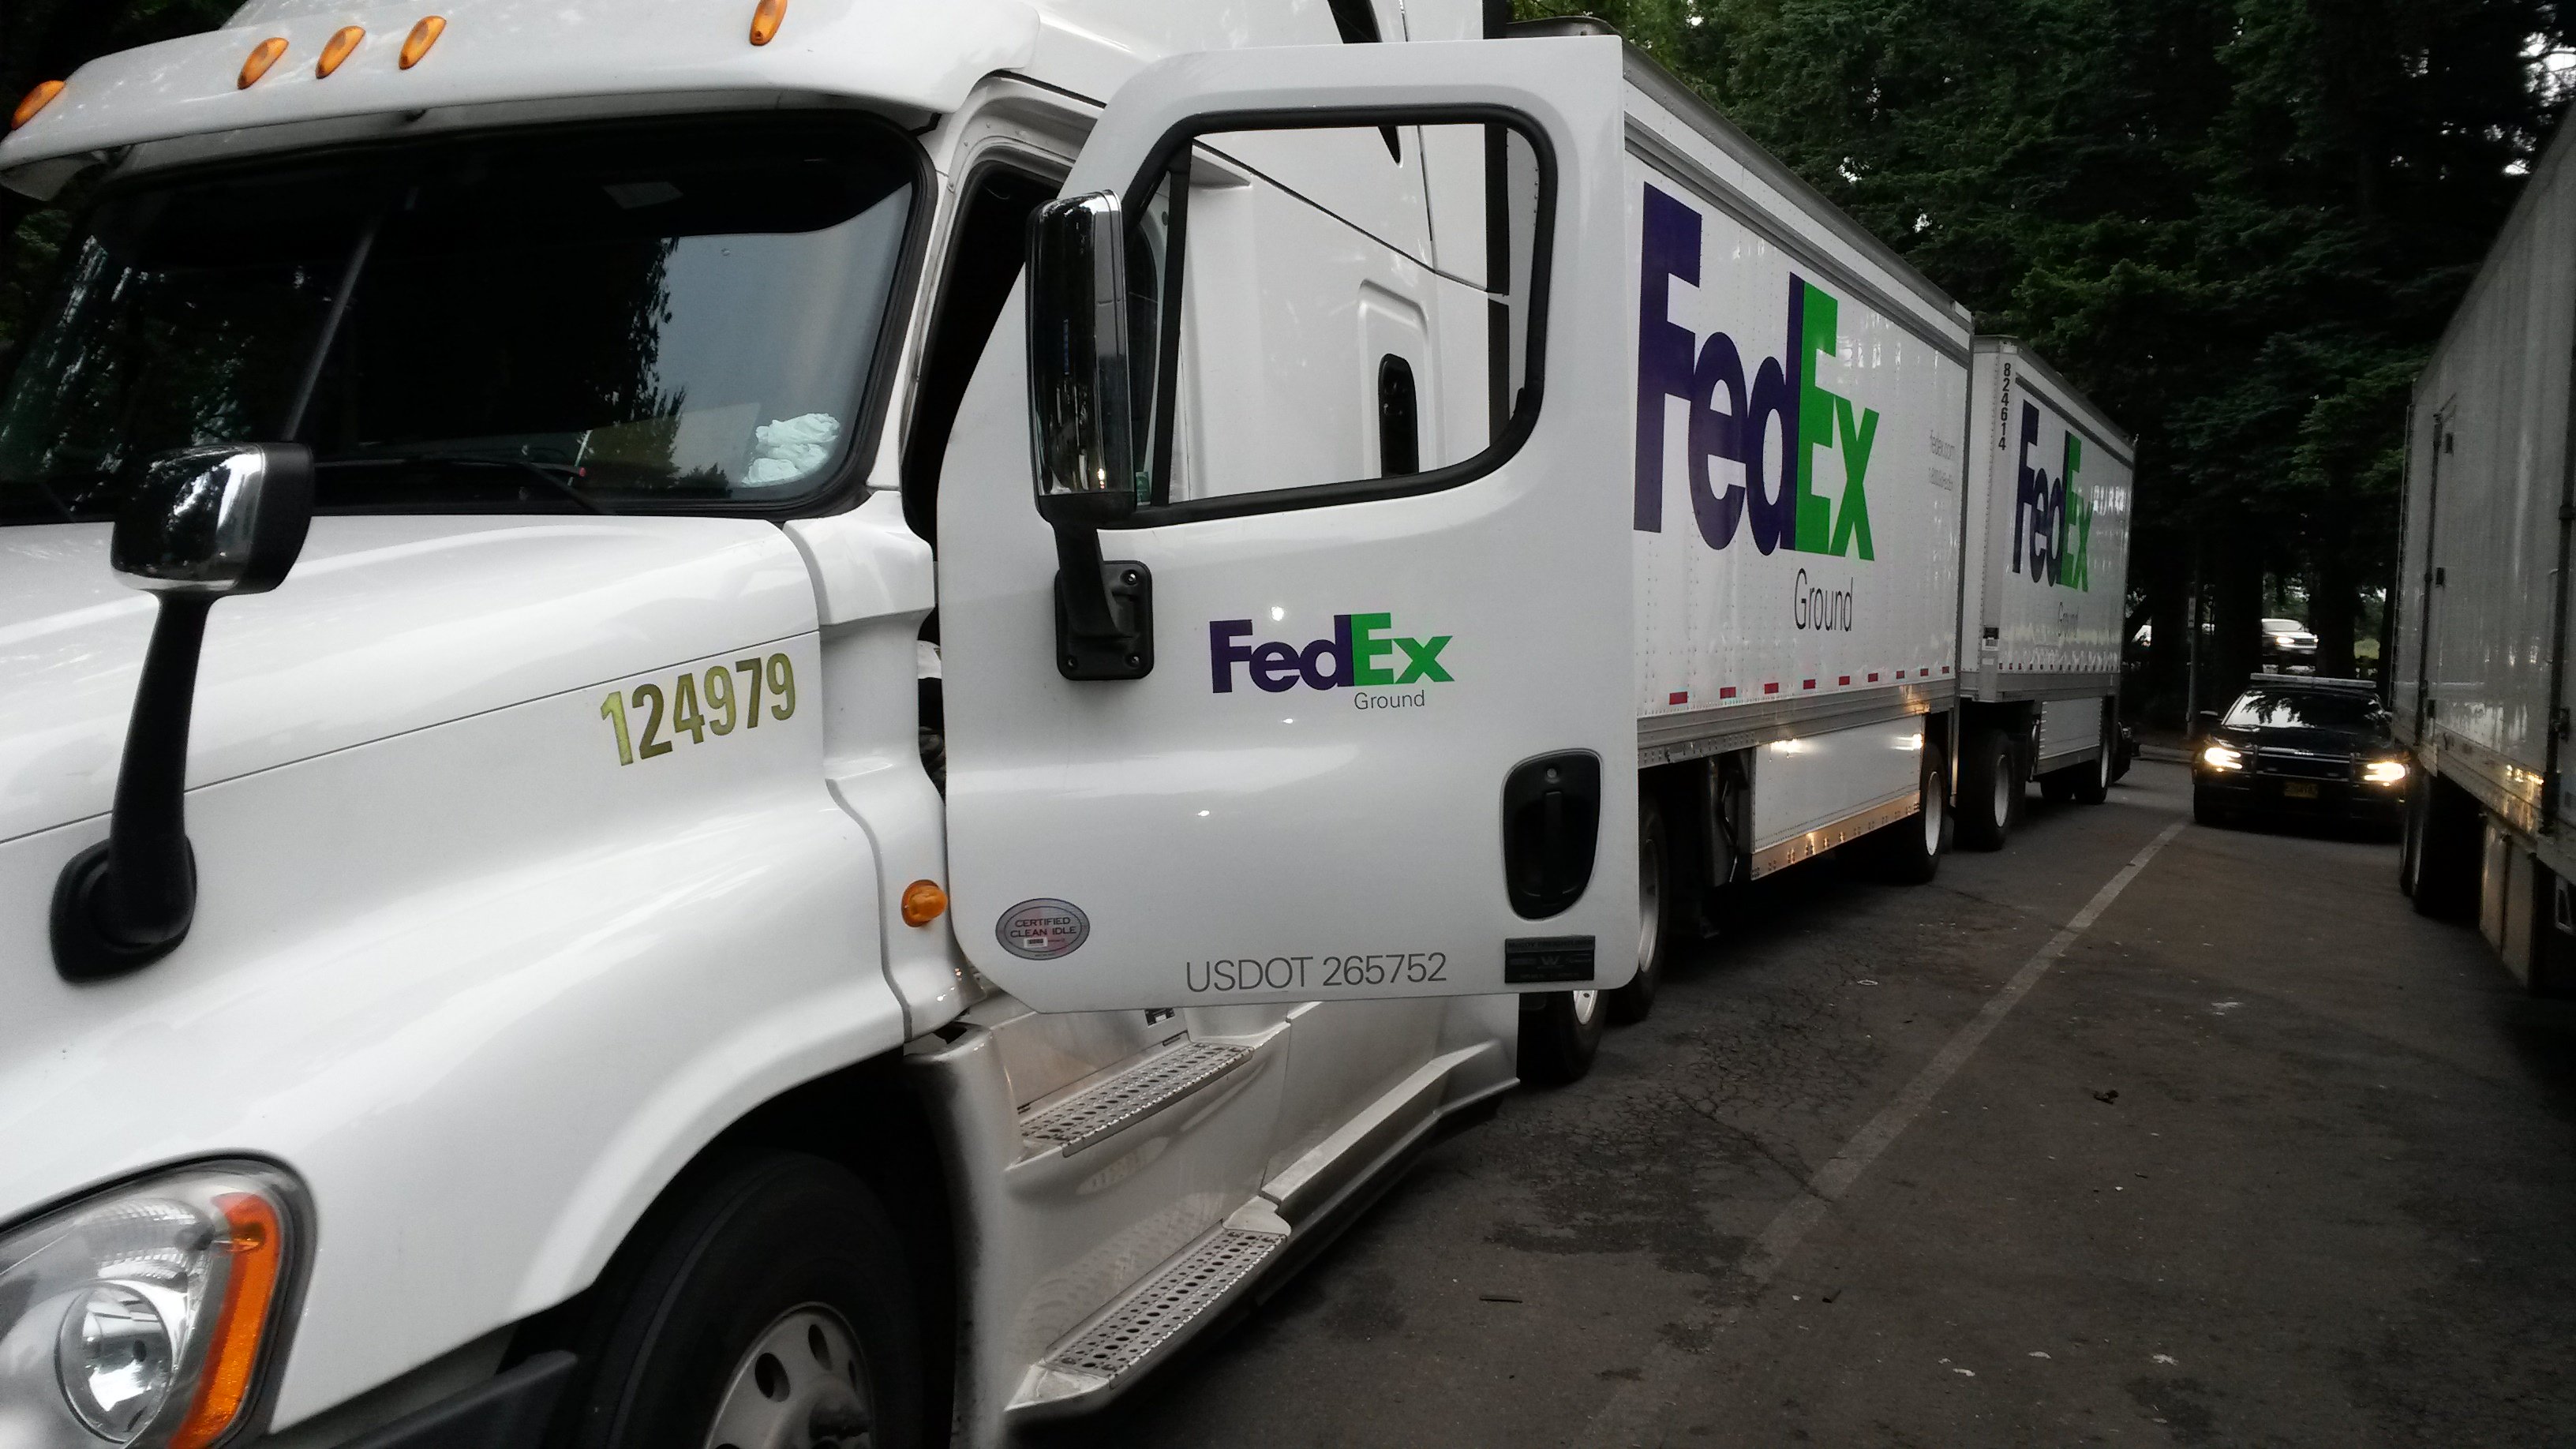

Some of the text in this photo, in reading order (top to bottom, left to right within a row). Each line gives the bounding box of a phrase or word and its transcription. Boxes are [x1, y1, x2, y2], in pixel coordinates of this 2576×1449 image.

[1634, 181, 1880, 561] FedEx
[1998, 362, 2012, 451] 824614
[2012, 399, 2094, 593] FedEx
[1794, 567, 1854, 632] Ground
[1209, 612, 1456, 694] FedEx
[600, 652, 796, 766] 124979
[1354, 689, 1425, 710] Ground
[1010, 926, 1077, 938] CLEAN IDLE
[1014, 916, 1071, 928] CERTIFIED
[1186, 952, 1447, 993] USDOT 265752
